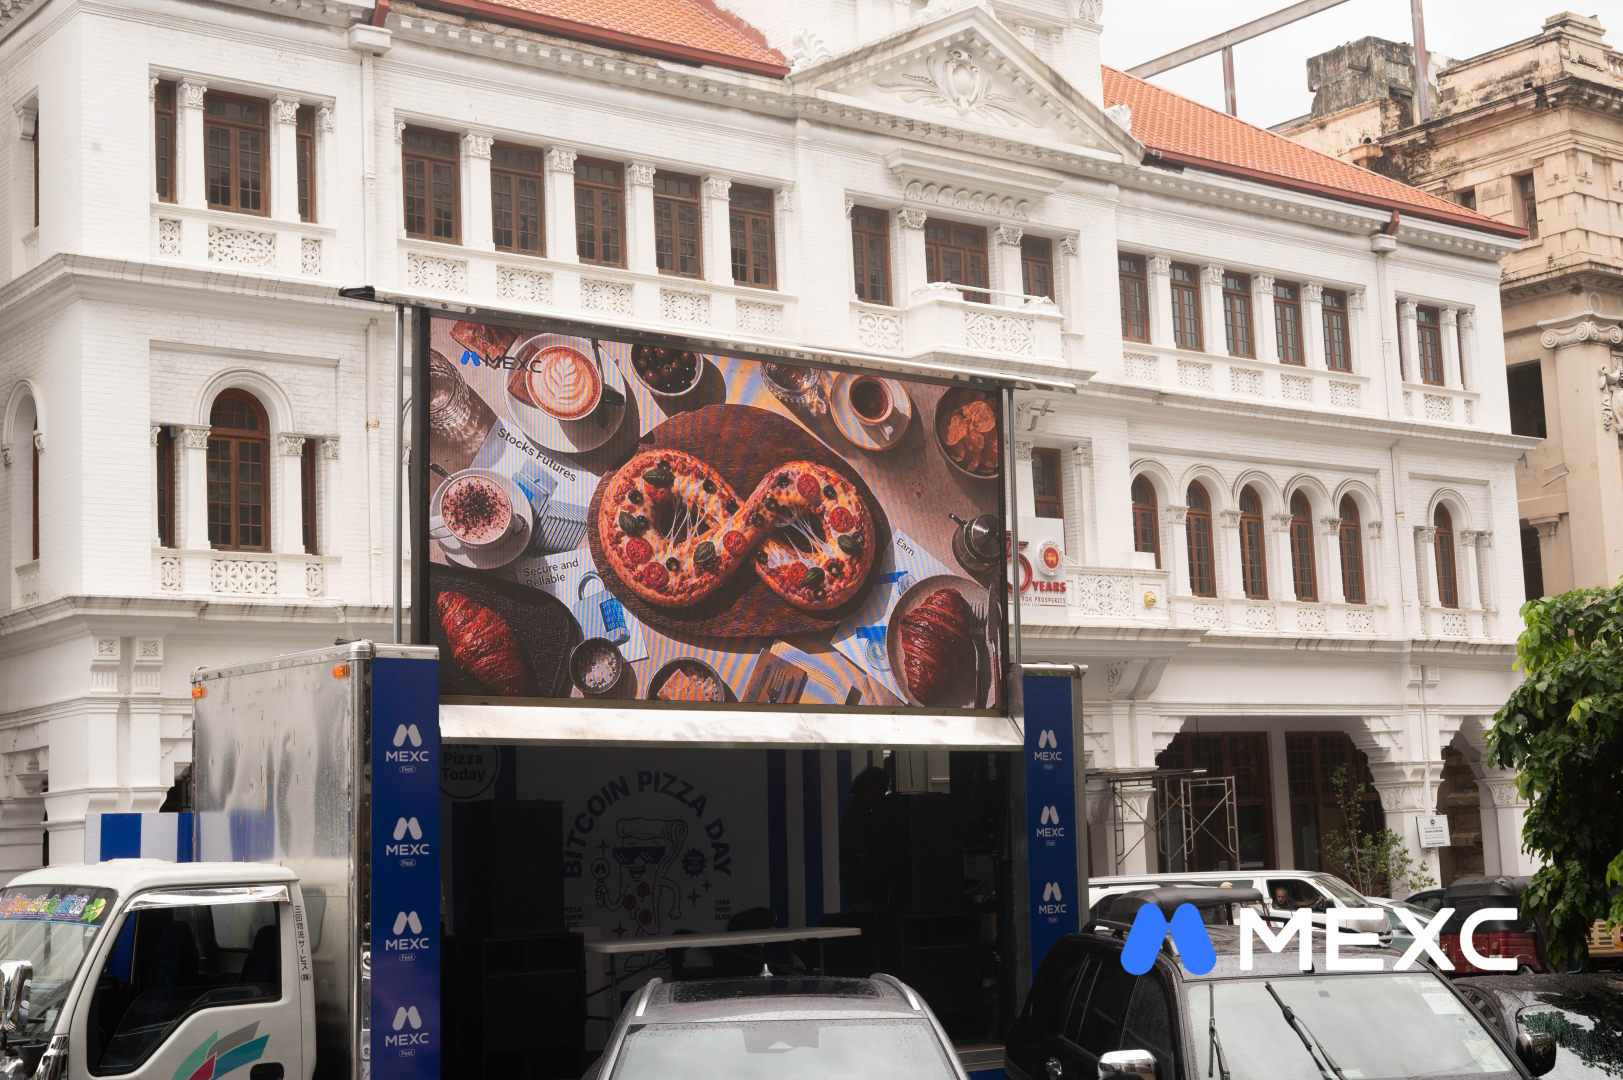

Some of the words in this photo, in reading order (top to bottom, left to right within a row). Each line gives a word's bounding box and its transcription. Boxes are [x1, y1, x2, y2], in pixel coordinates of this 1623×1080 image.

[485, 353, 542, 373] MEXC
[498, 427, 535, 456] Stocks
[536, 451, 577, 482] Futures
[896, 537, 915, 556] Earn
[523, 563, 558, 577] Secure
[561, 558, 579, 568] and
[526, 573, 566, 588] Reliable
[1032, 581, 1067, 594] YEARS
[1034, 596, 1066, 604] PROSPERITY
[385, 751, 429, 762] MEXC
[443, 751, 483, 765] Pizza
[1034, 752, 1062, 761] MEXC
[441, 768, 485, 783] Today
[563, 775, 630, 878] BITCOIN
[638, 770, 707, 818] PIZZA
[705, 818, 732, 877] DAY
[1036, 828, 1064, 837] MEXC
[385, 844, 430, 856] MEXC
[1038, 904, 1067, 914] MEXC
[385, 937, 430, 950] MEXC
[385, 1032, 429, 1047] MEXC
